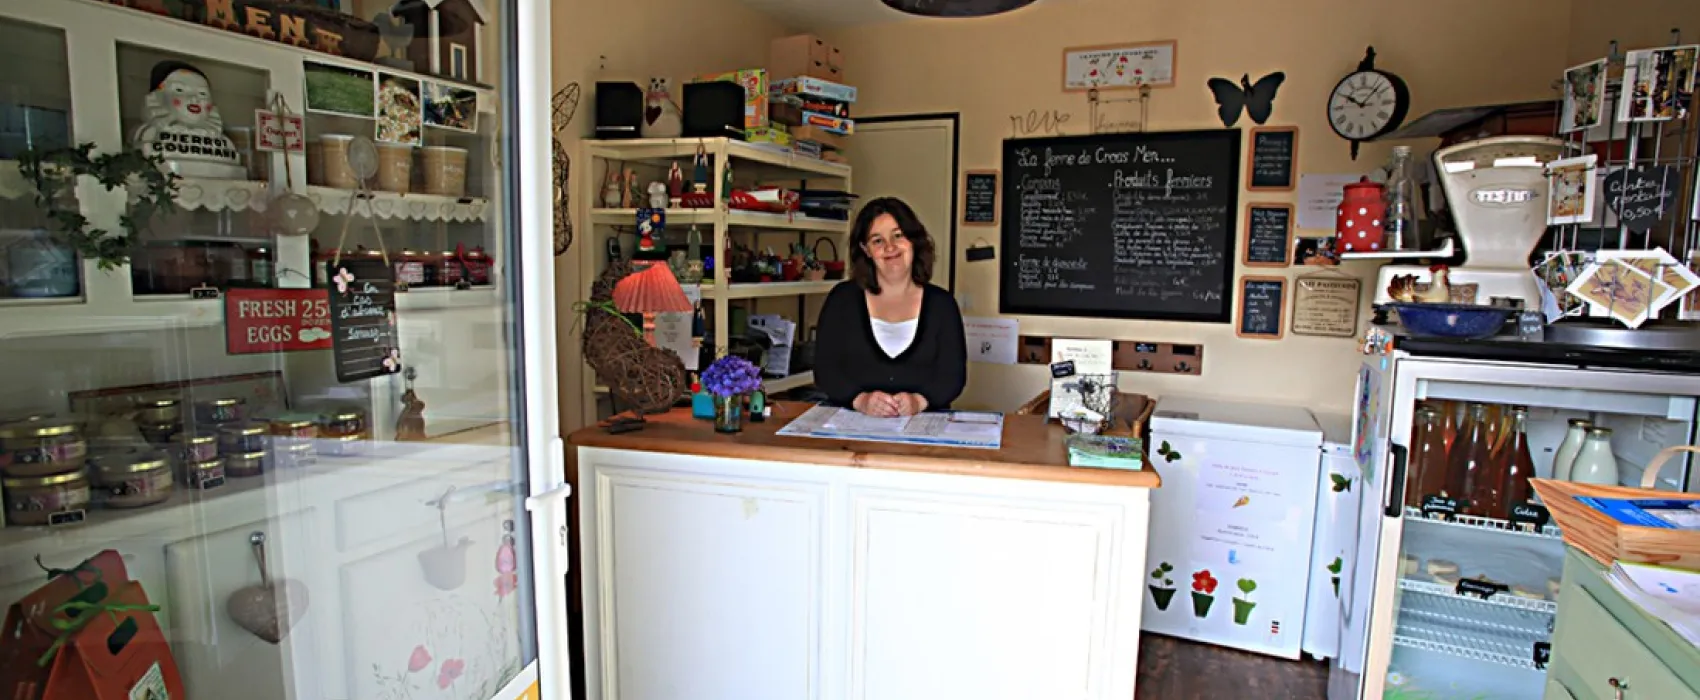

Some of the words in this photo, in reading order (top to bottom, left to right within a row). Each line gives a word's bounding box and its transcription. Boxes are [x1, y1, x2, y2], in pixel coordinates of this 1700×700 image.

[1015, 148, 1038, 167] La
[1077, 150, 1092, 166] de
[1113, 169, 1159, 188] Produits
[238, 300, 297, 318] FRESH
[247, 325, 292, 344] EGGS
